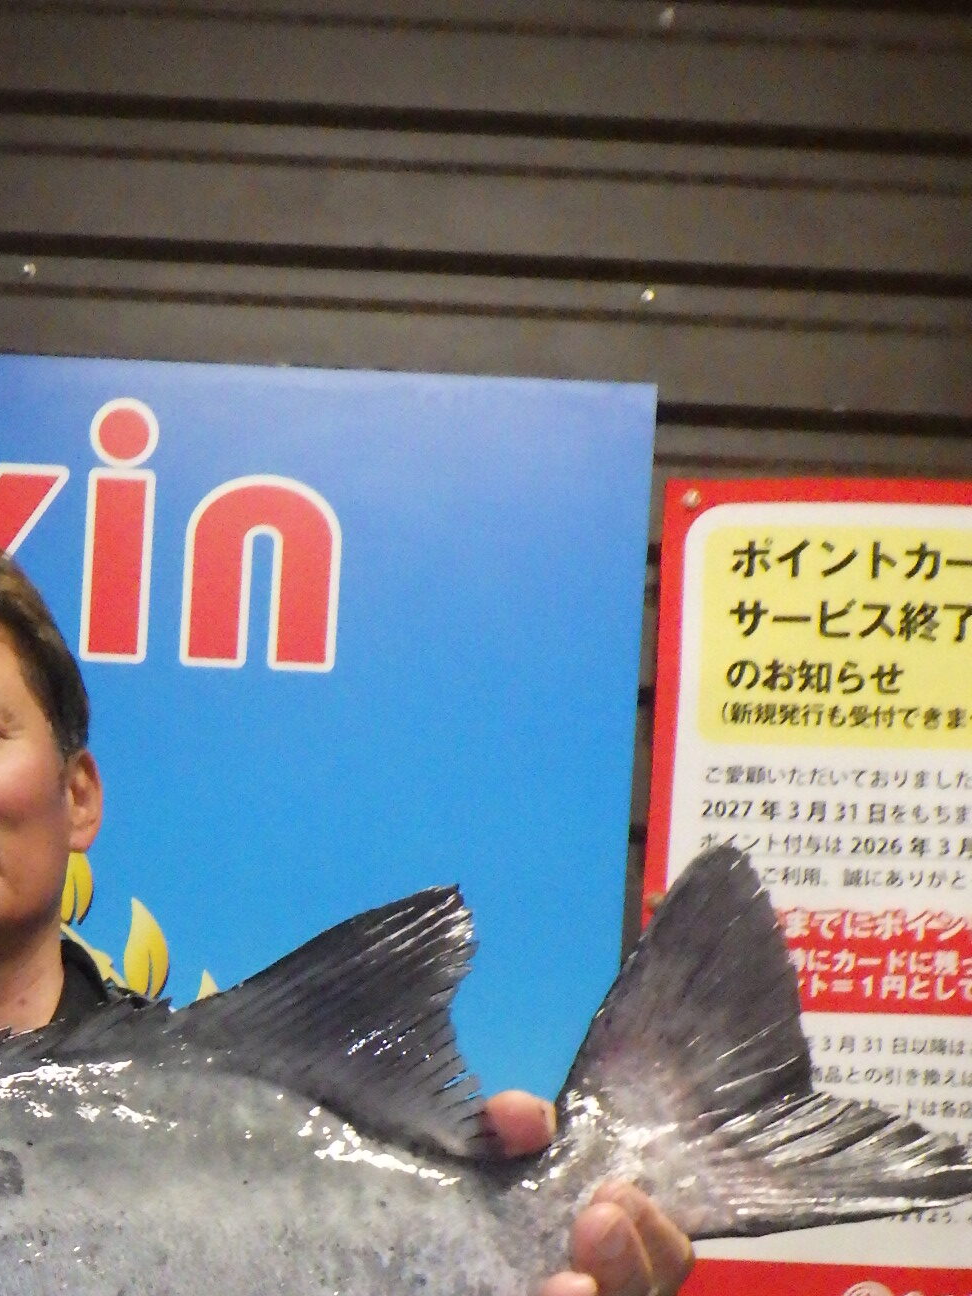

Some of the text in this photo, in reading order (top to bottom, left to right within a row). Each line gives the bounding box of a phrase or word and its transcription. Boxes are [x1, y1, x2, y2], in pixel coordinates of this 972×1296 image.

[731, 538, 972, 580] ポイントカー
[729, 600, 972, 643] サービス終了
[726, 658, 904, 695] のお知らせ
